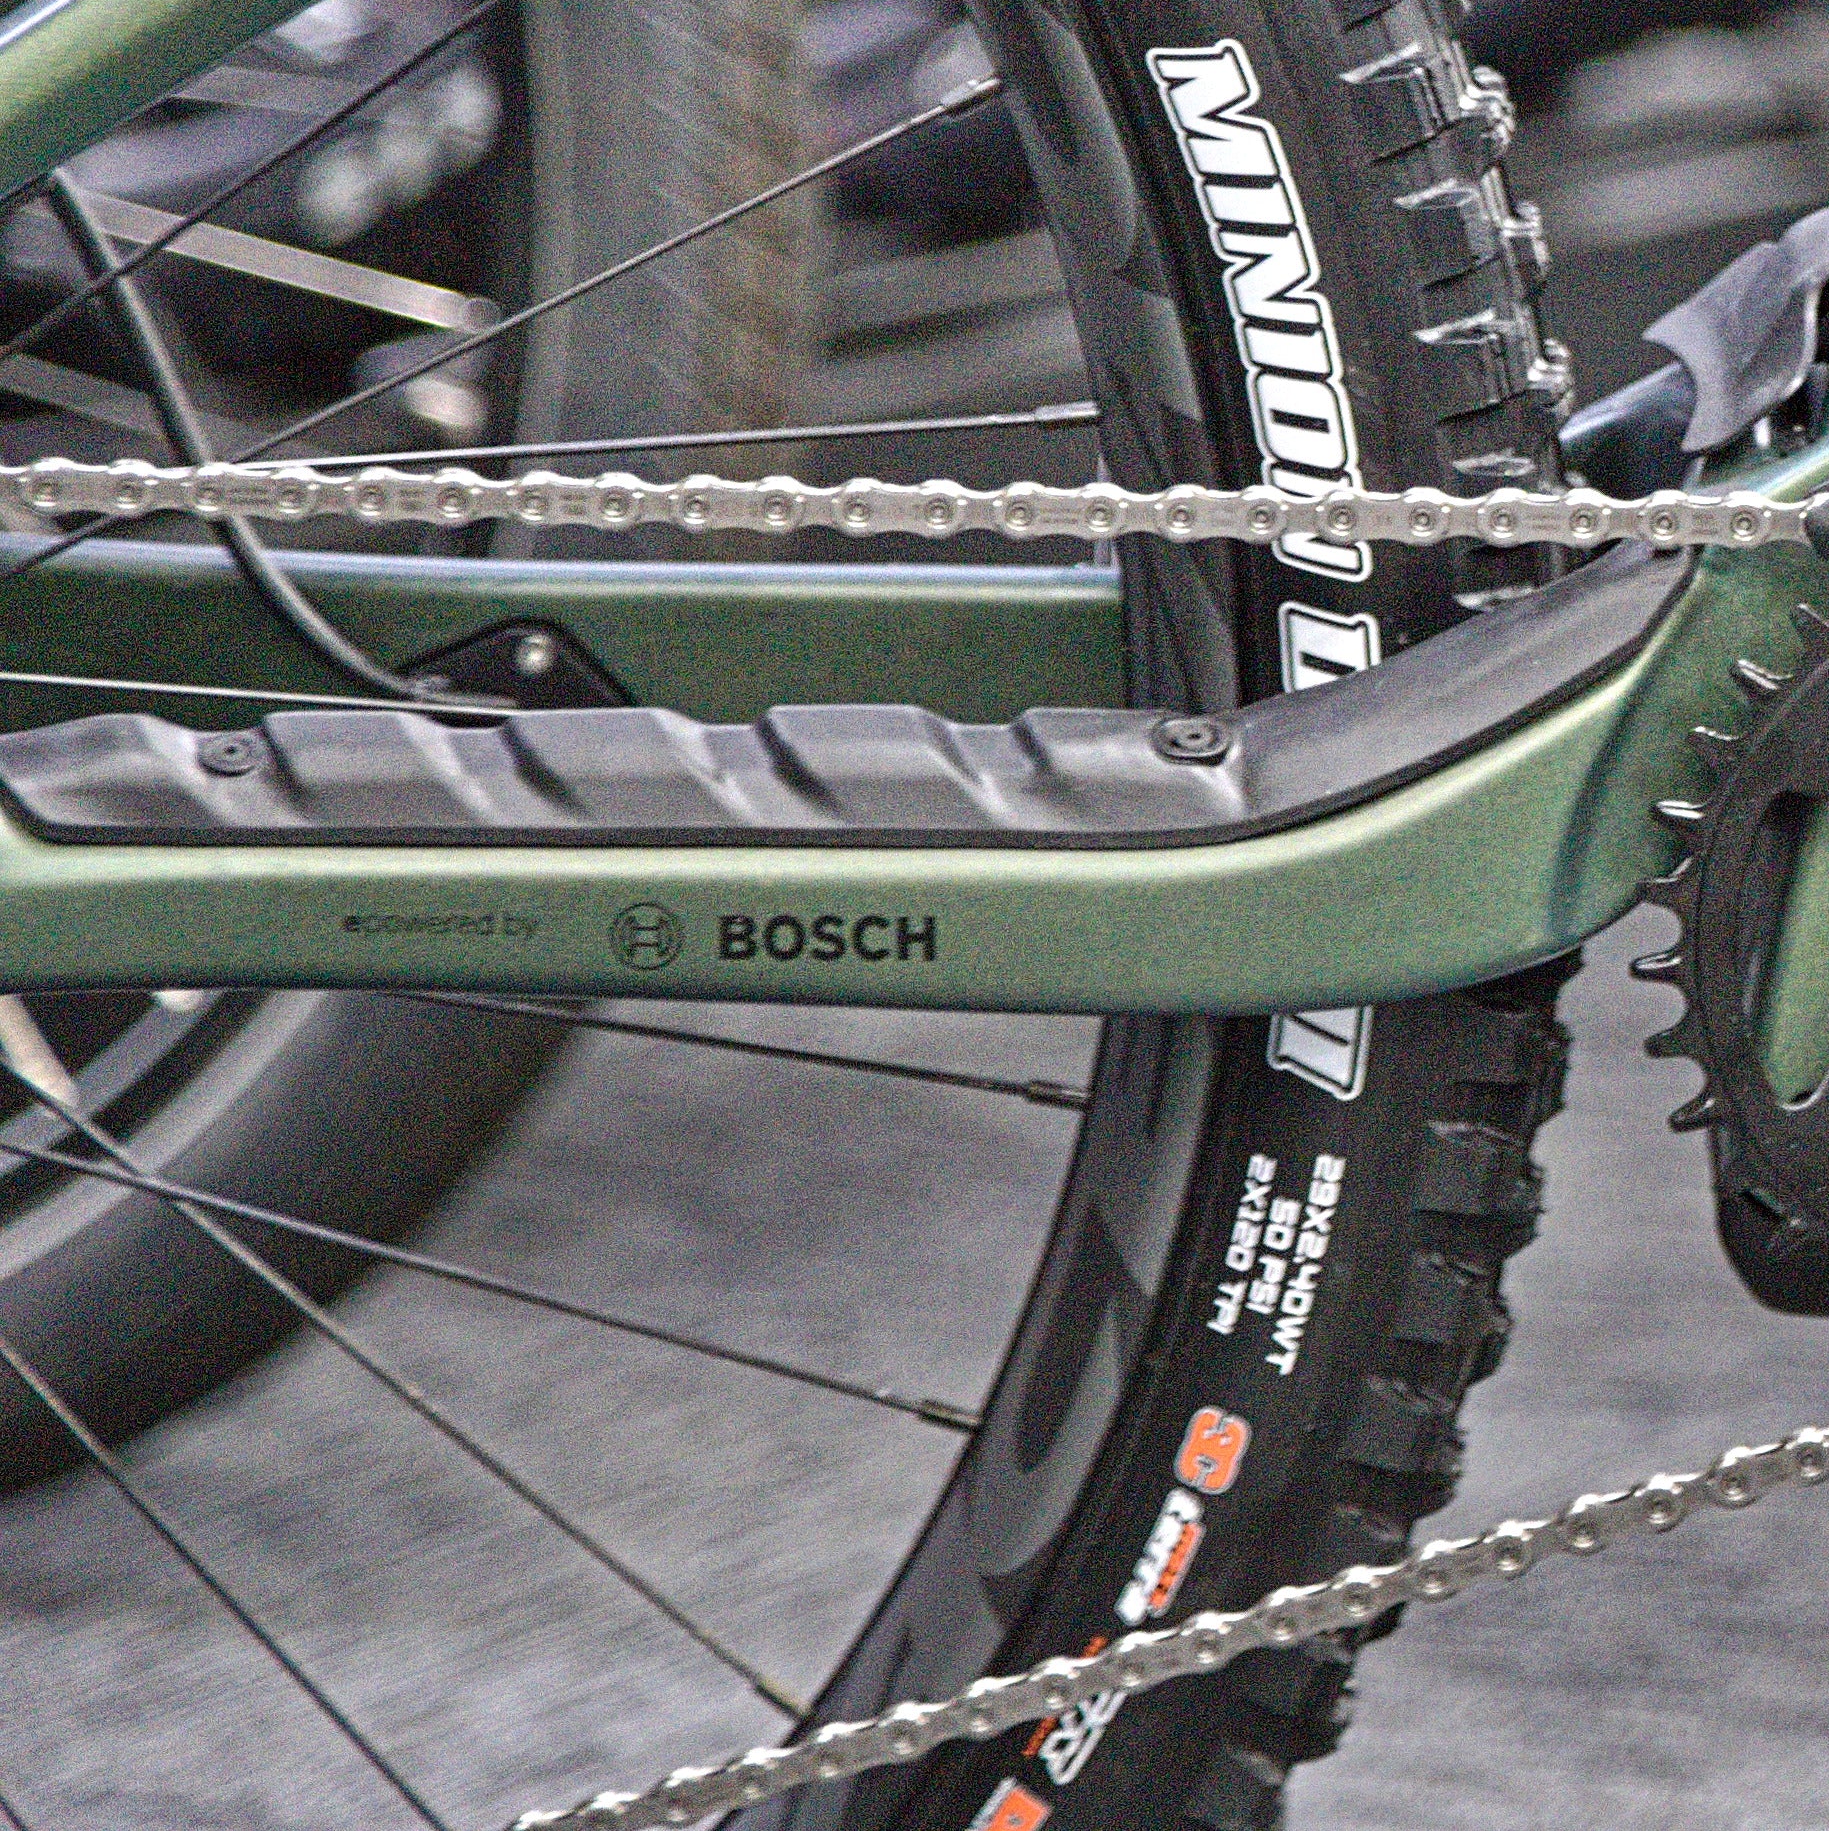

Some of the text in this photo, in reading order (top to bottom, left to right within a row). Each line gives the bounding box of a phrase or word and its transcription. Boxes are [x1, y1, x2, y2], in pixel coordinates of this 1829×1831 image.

[719, 914, 938, 962] BOSCH
[1207, 1153, 1277, 1335] 2X120 TPI
[1246, 1197, 1302, 1315] 50 PSI
